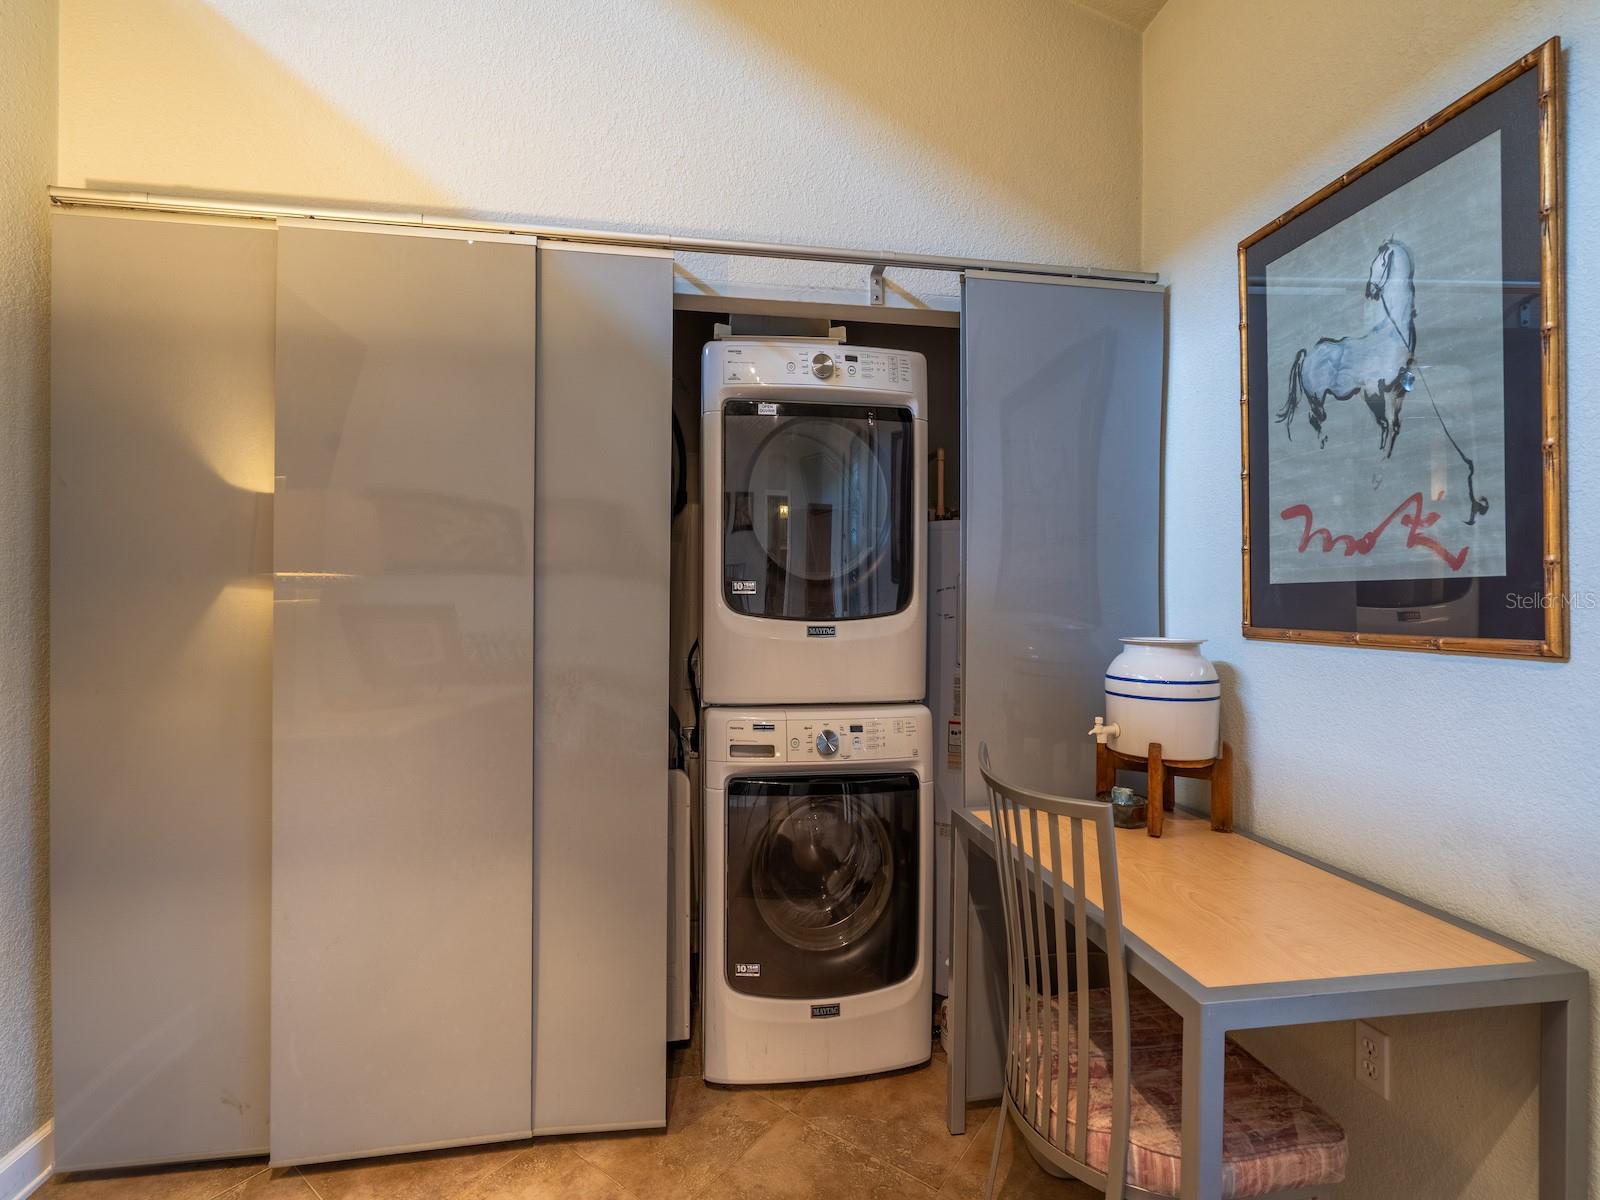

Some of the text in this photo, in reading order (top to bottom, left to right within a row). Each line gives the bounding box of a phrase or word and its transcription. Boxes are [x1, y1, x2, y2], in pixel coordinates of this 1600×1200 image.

[734, 582, 743, 590] 10
[809, 627, 835, 635] MAYTAG
[736, 965, 747, 973] 10
[812, 1006, 839, 1016] MAYTAG
